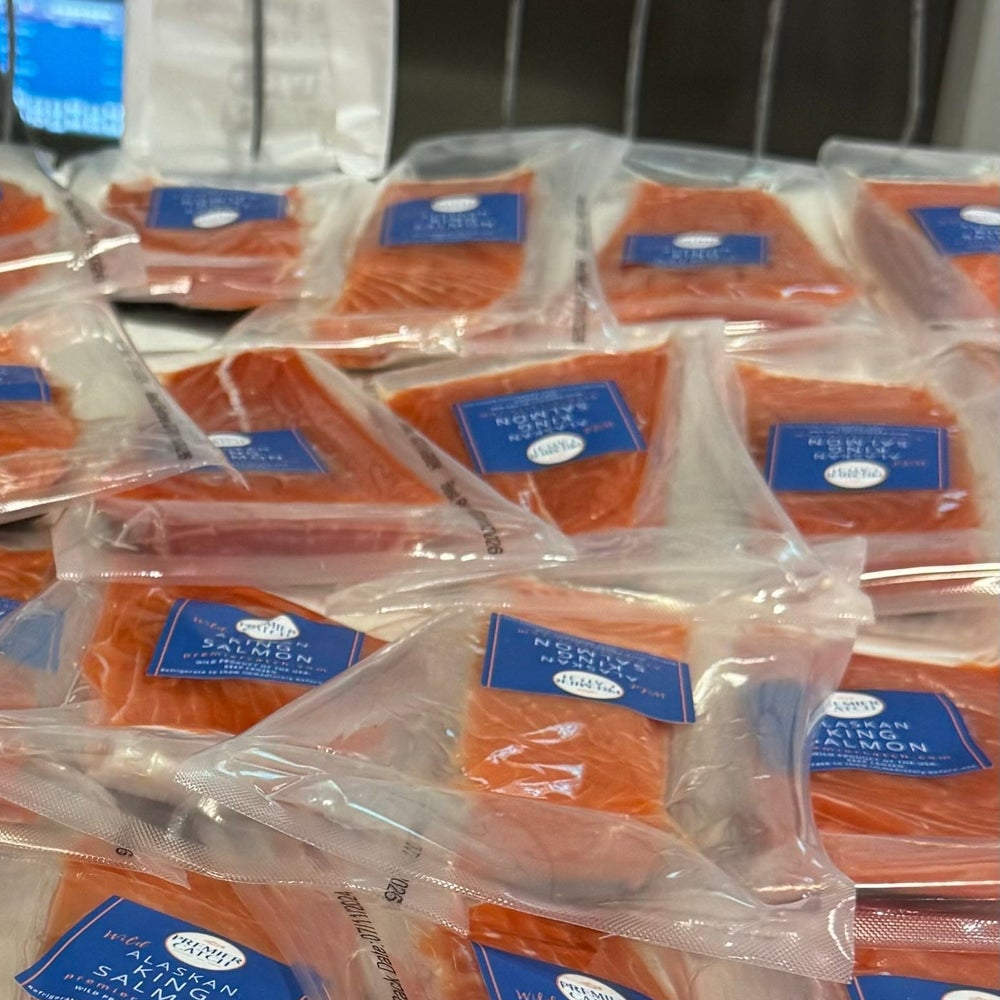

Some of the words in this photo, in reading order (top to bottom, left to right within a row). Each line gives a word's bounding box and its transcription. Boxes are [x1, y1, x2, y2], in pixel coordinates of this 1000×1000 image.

[202, 638, 312, 664] SALMON
[827, 729, 897, 739] KING
[815, 738, 927, 752] ALMON
[104, 930, 151, 948] Wild
[172, 935, 243, 965] PREMIER
[173, 942, 230, 967] CATCH
[126, 950, 238, 996] ALASKAN
[75, 985, 99, 996] WILD
